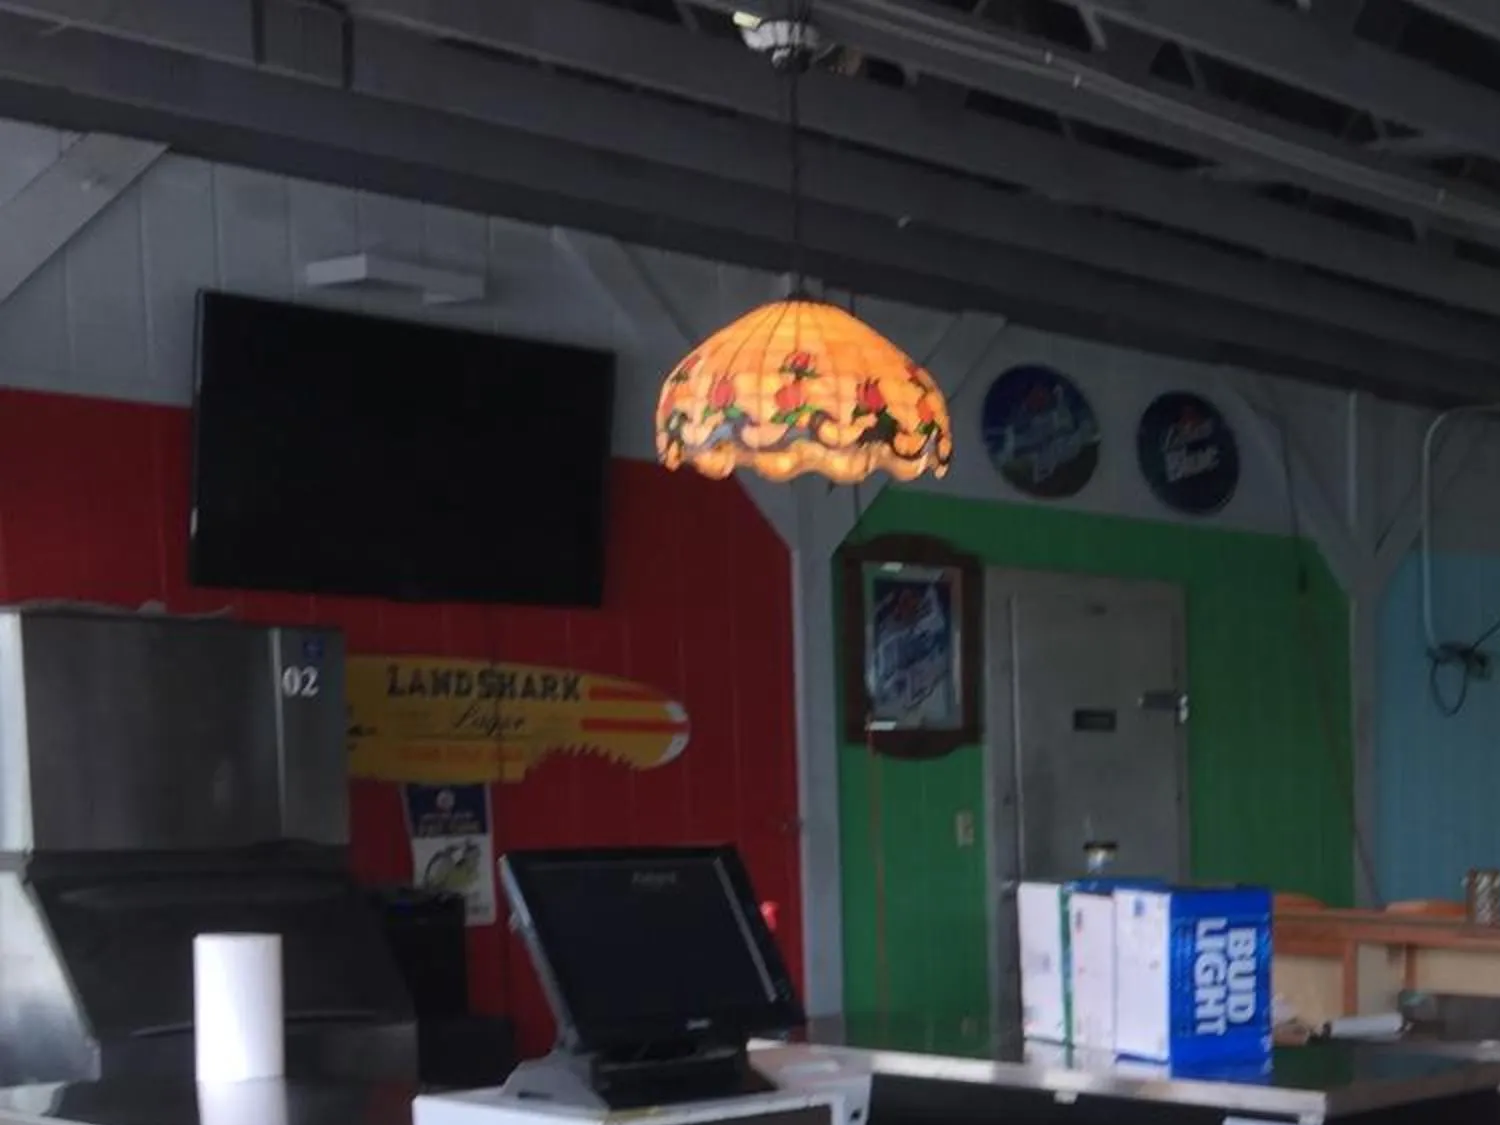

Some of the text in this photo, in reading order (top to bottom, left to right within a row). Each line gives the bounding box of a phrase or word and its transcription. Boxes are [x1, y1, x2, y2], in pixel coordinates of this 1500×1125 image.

[282, 666, 320, 697] 02
[1195, 917, 1228, 1036] LIGHT
[1228, 928, 1257, 1025] BUD
